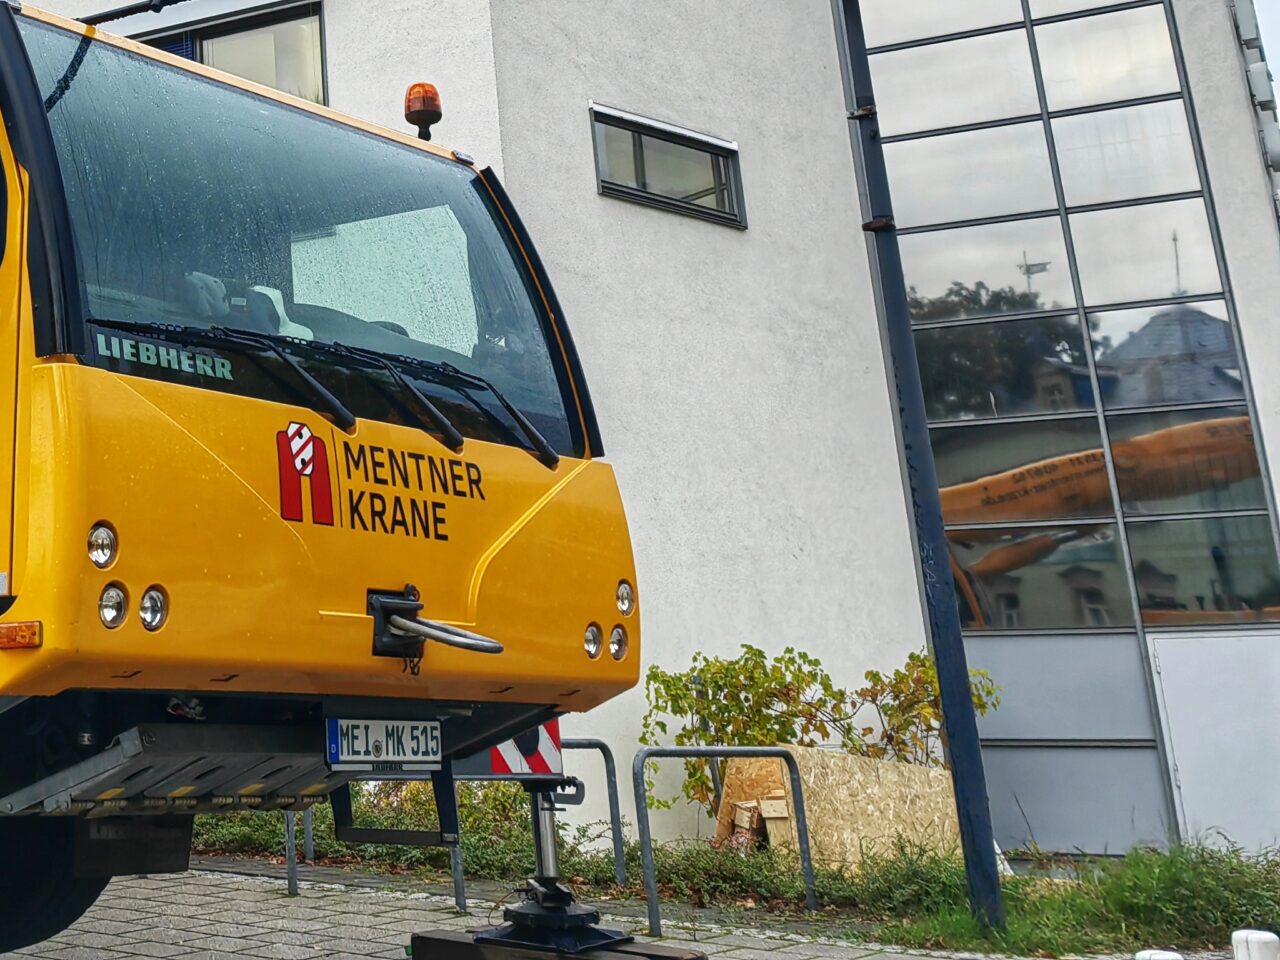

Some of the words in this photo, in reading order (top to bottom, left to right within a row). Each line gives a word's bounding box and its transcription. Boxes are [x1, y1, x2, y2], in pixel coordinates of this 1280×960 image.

[97, 334, 234, 381] LIEBHERR
[343, 440, 486, 502] MENTNER
[348, 488, 449, 542] KRANE
[331, 744, 336, 753] D
[340, 724, 371, 756] MEI
[385, 725, 406, 756] MK
[410, 726, 439, 756] 515
